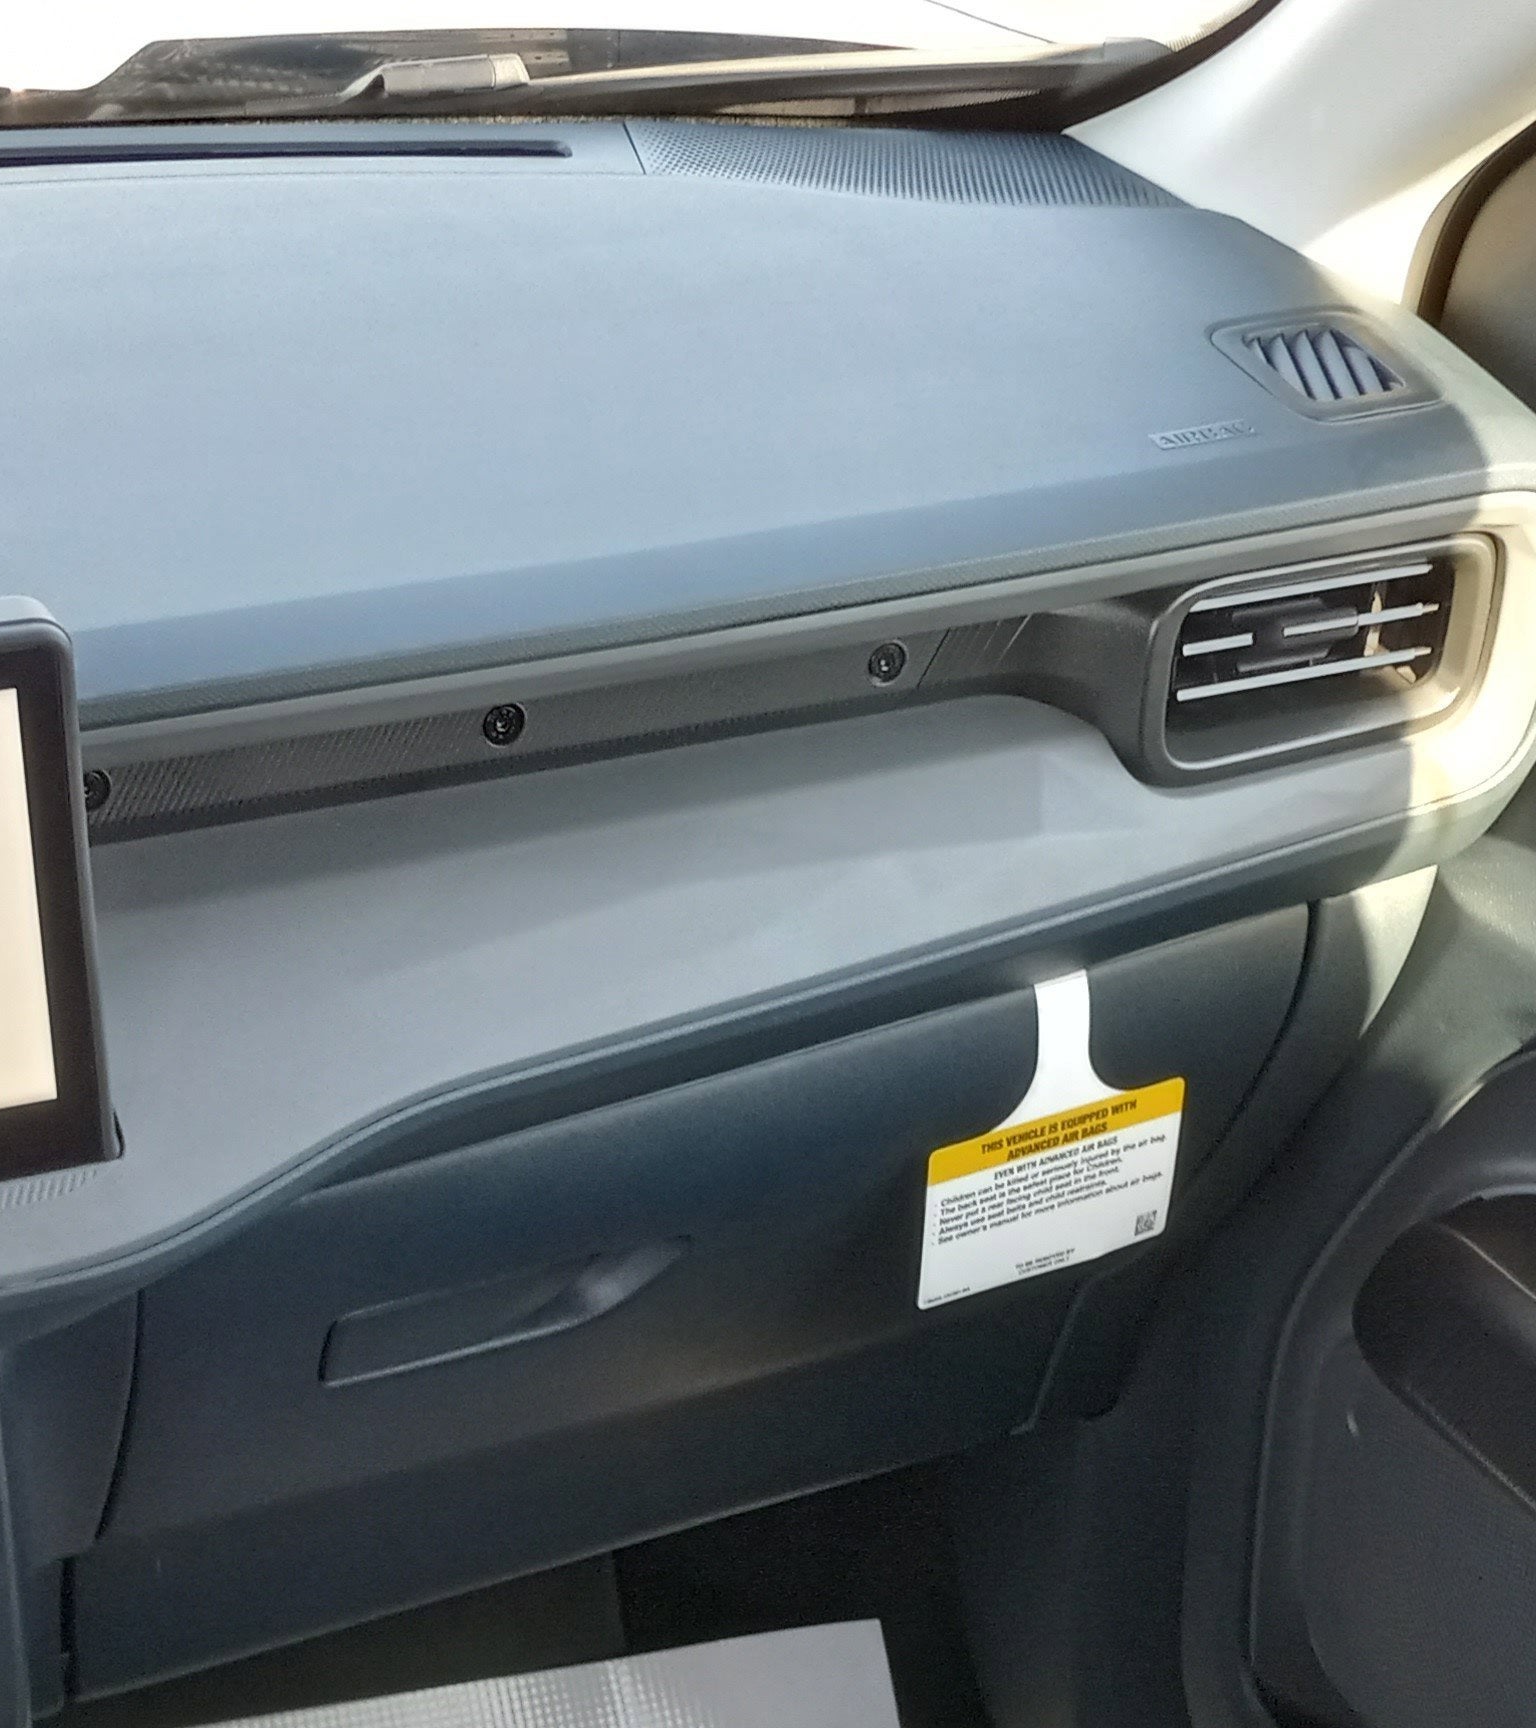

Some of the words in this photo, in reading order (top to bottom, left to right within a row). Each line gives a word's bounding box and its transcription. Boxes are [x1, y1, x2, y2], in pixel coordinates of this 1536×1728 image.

[981, 1139, 1004, 1155] THIS
[1005, 1126, 1046, 1147] VEHICLE
[1048, 1123, 1059, 1135] IS
[1061, 1108, 1109, 1132] EQUIPPED
[1110, 1099, 1138, 1116] WITH
[1006, 1136, 1060, 1162] ADVANCED
[1062, 1130, 1080, 1143] AIR
[1081, 1122, 1109, 1139] BAGS
[1039, 1147, 1080, 1166] ADVANCED
